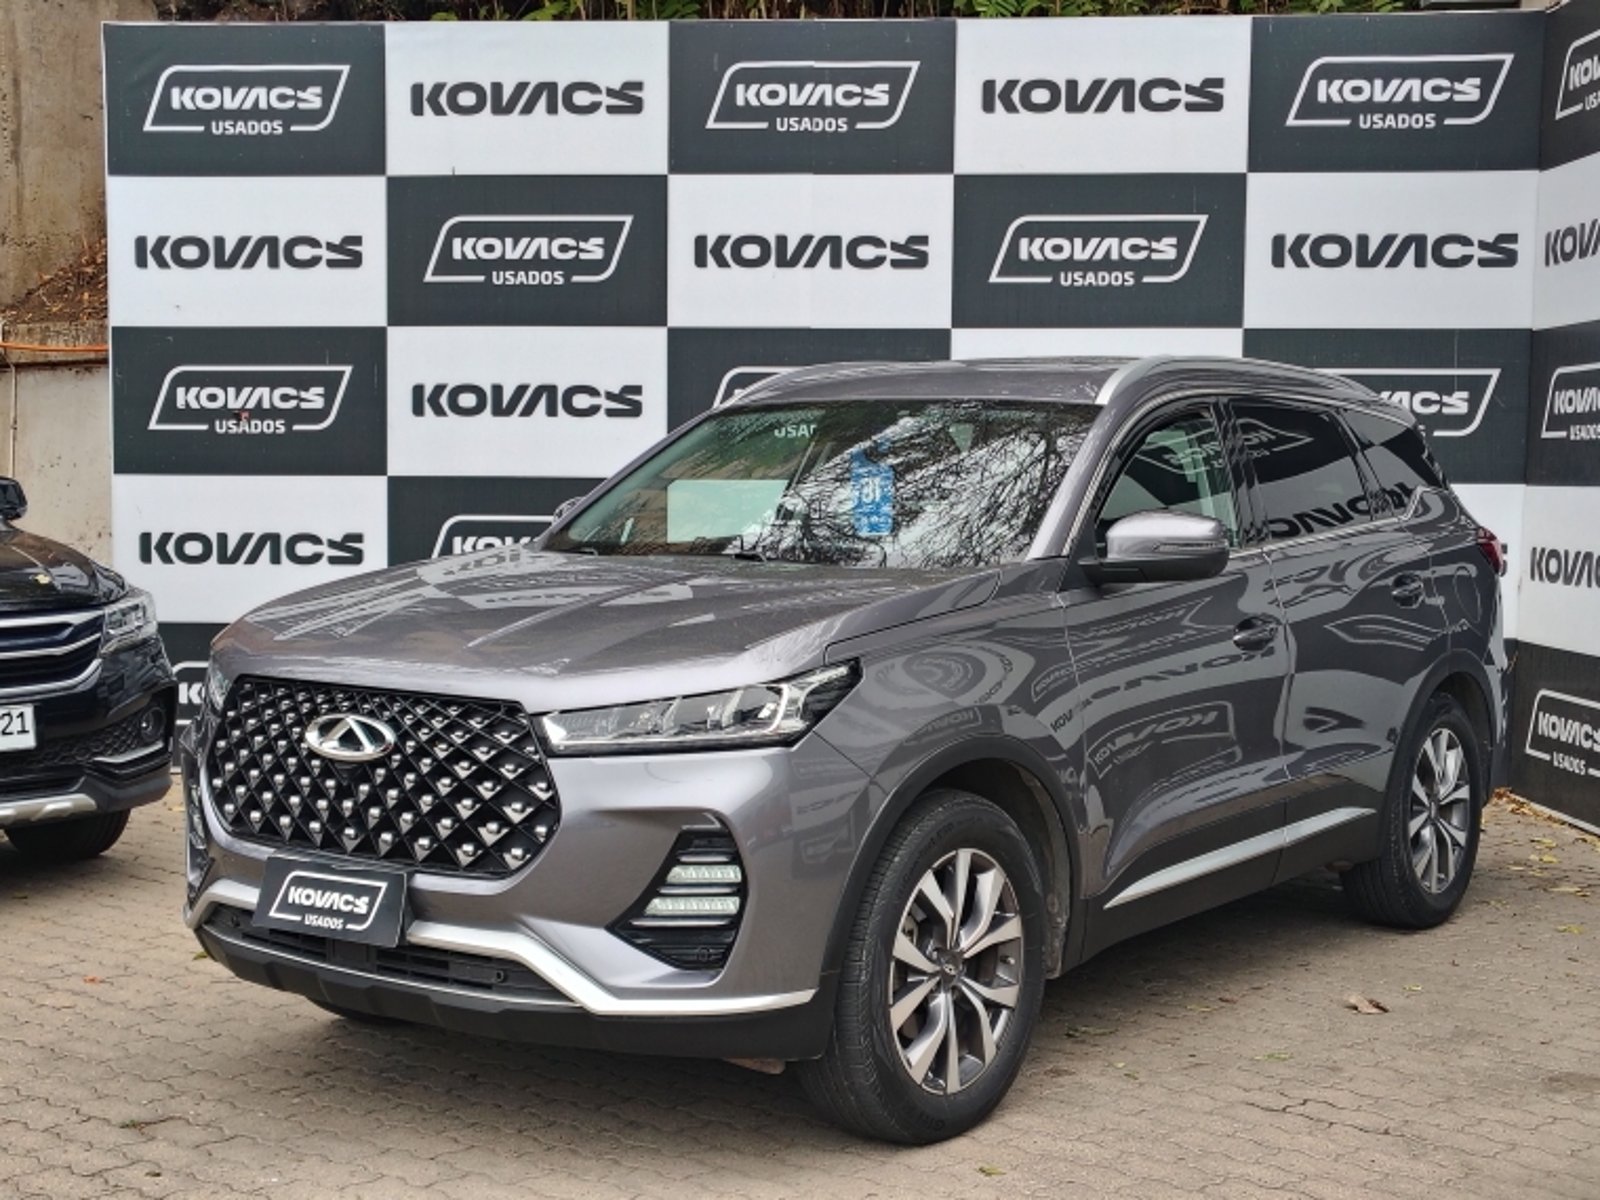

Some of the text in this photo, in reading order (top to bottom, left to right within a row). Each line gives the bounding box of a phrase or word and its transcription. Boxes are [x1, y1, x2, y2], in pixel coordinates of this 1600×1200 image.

[171, 86, 322, 110] KOVACS
[410, 81, 643, 117] KOVACS
[736, 82, 889, 107] KOVACS
[982, 77, 1225, 114] KOVACS
[1317, 77, 1481, 103] KOVACS
[211, 119, 284, 136] USADOS
[776, 116, 848, 132] USADOS
[1358, 113, 1436, 129] USADOS
[135, 235, 363, 270] KOVACS
[452, 237, 605, 260] KOVACS
[694, 235, 929, 269] KOVACS
[1019, 237, 1178, 261] KOVACS
[1272, 233, 1519, 269] KOVACS
[492, 270, 565, 285] USADOS
[1059, 271, 1135, 287] USADOS
[176, 386, 325, 409] KOVACS
[411, 383, 643, 418] KOVACS
[214, 419, 286, 434] USADOS
[139, 531, 364, 566] KOVACS
[287, 885, 370, 915] KOVACS
[304, 912, 345, 931] USADOS
